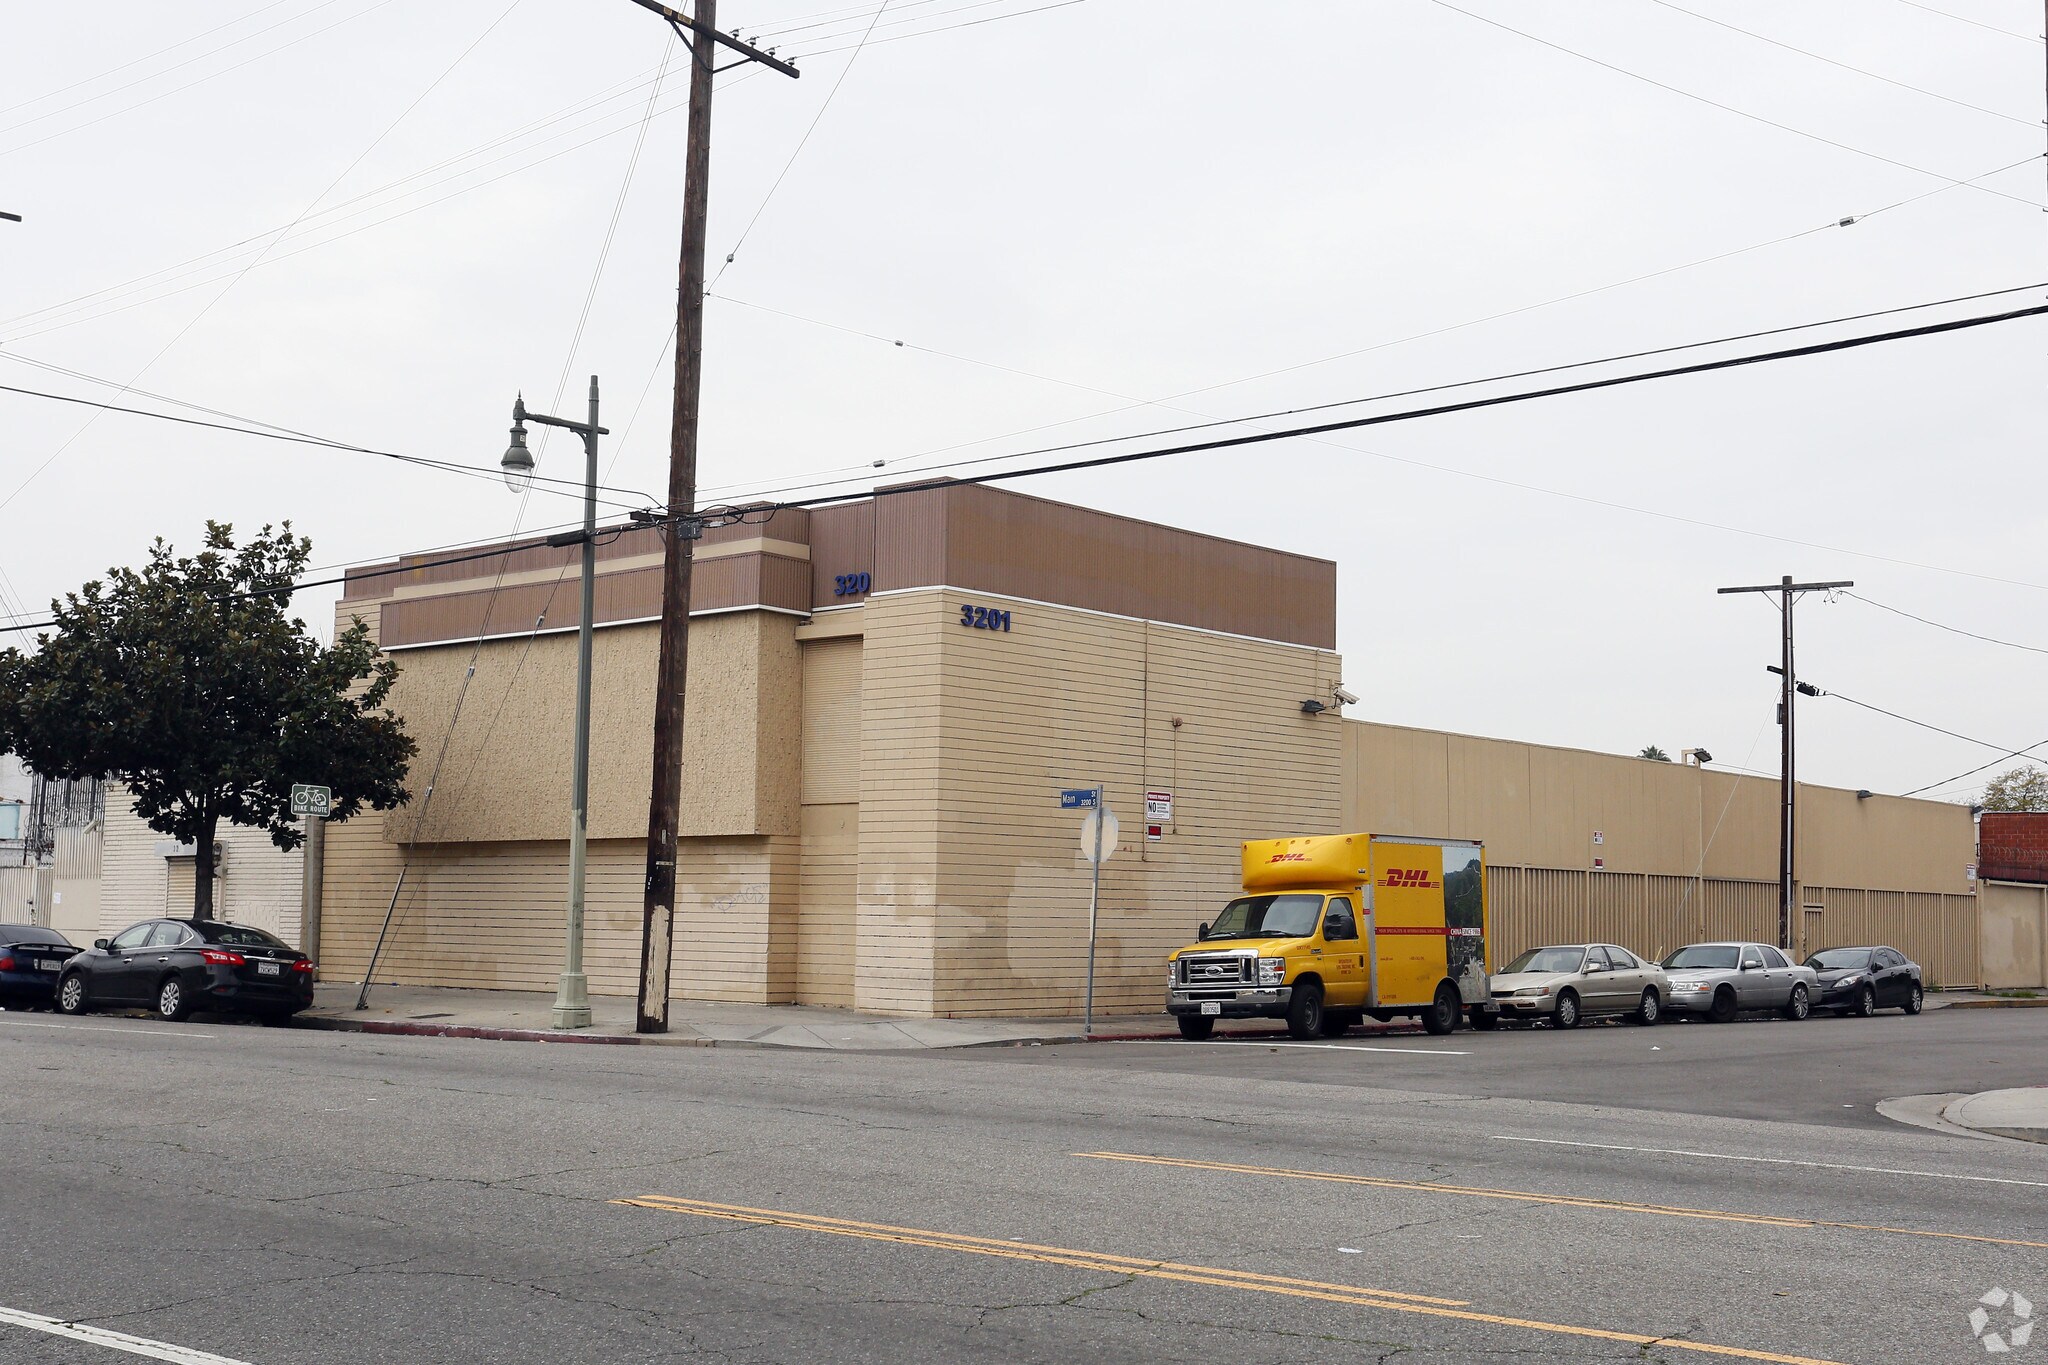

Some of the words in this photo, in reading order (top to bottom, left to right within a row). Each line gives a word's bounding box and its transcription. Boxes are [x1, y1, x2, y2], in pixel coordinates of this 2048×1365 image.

[960, 604, 1011, 632] 3201
[1062, 794, 1076, 804] Main
[294, 804, 308, 812] BIKE
[310, 805, 328, 814] ROUTE
[1148, 802, 1156, 813] NO
[1270, 853, 1305, 863] DHL
[1386, 868, 1432, 888] DHL
